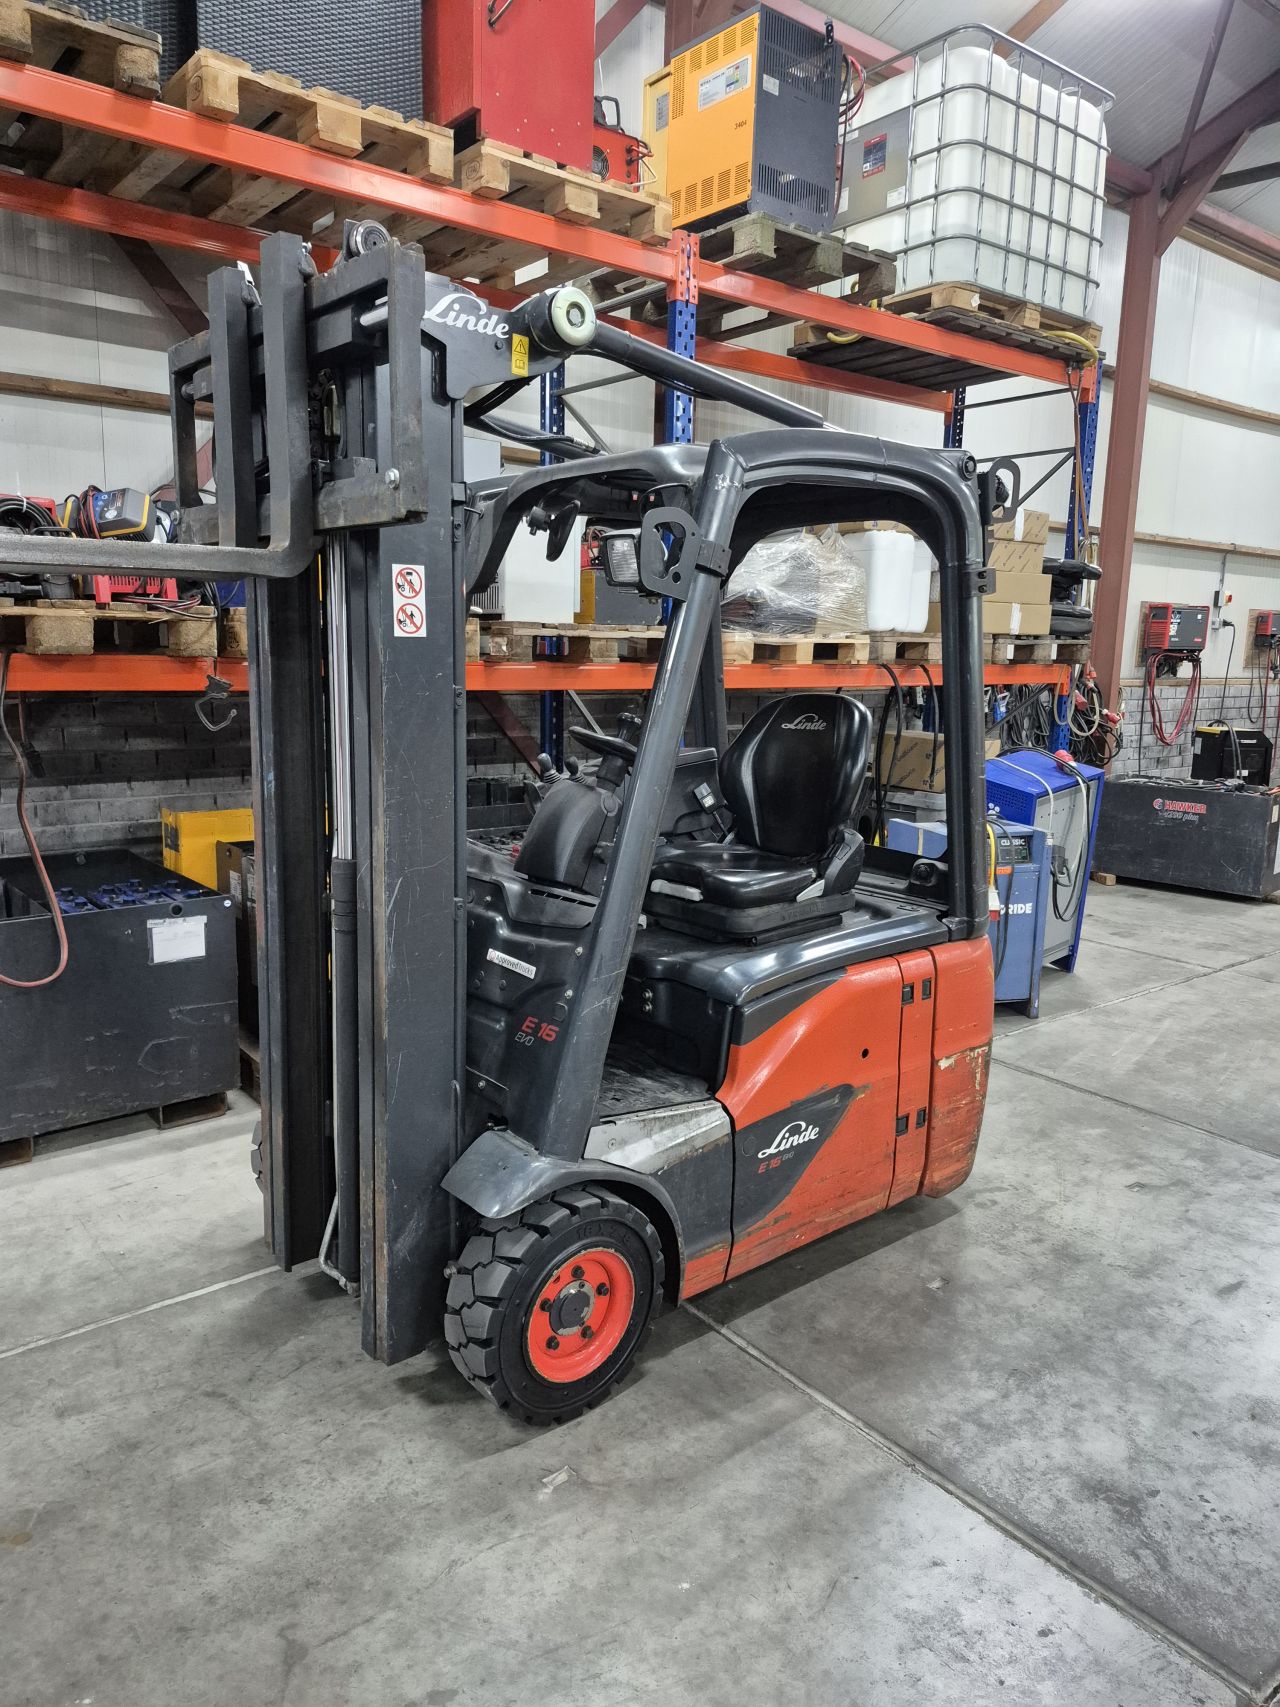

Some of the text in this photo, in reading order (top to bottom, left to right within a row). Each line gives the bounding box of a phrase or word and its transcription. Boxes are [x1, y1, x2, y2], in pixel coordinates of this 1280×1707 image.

[423, 293, 509, 338] Linde
[781, 713, 827, 731] Linde
[1164, 800, 1207, 814] HAWKER
[515, 1031, 534, 1046] EVO
[522, 1016, 560, 1042] E 16
[757, 1121, 819, 1158] Linde
